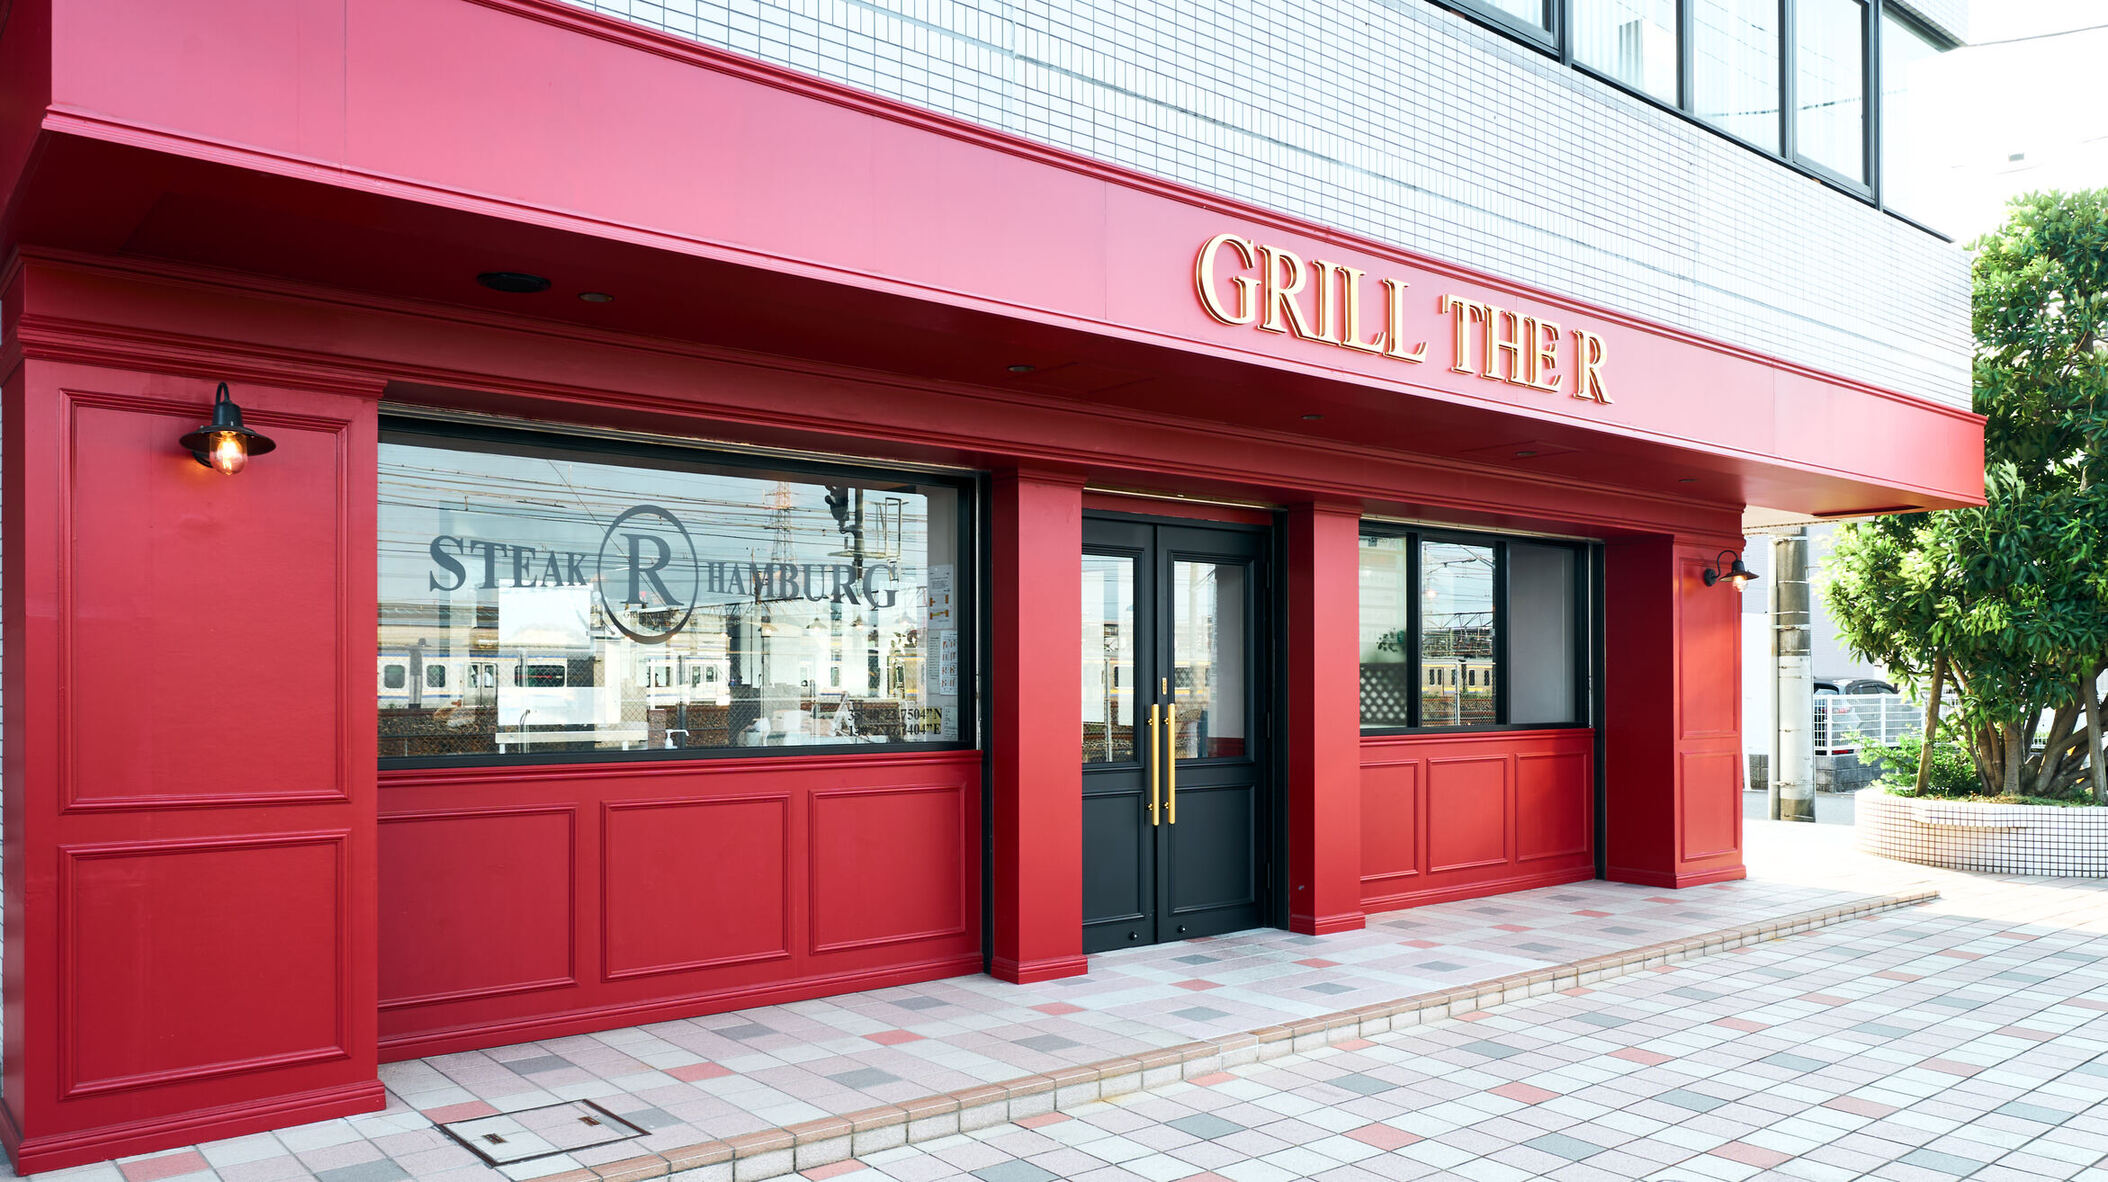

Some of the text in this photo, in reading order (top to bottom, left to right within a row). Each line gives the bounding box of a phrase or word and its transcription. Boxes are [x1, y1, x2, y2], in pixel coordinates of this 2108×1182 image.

[1195, 233, 1614, 405] GRILL THE R
[429, 534, 587, 592] STEAK
[619, 533, 684, 606] R
[706, 561, 899, 608] HAMBURG
